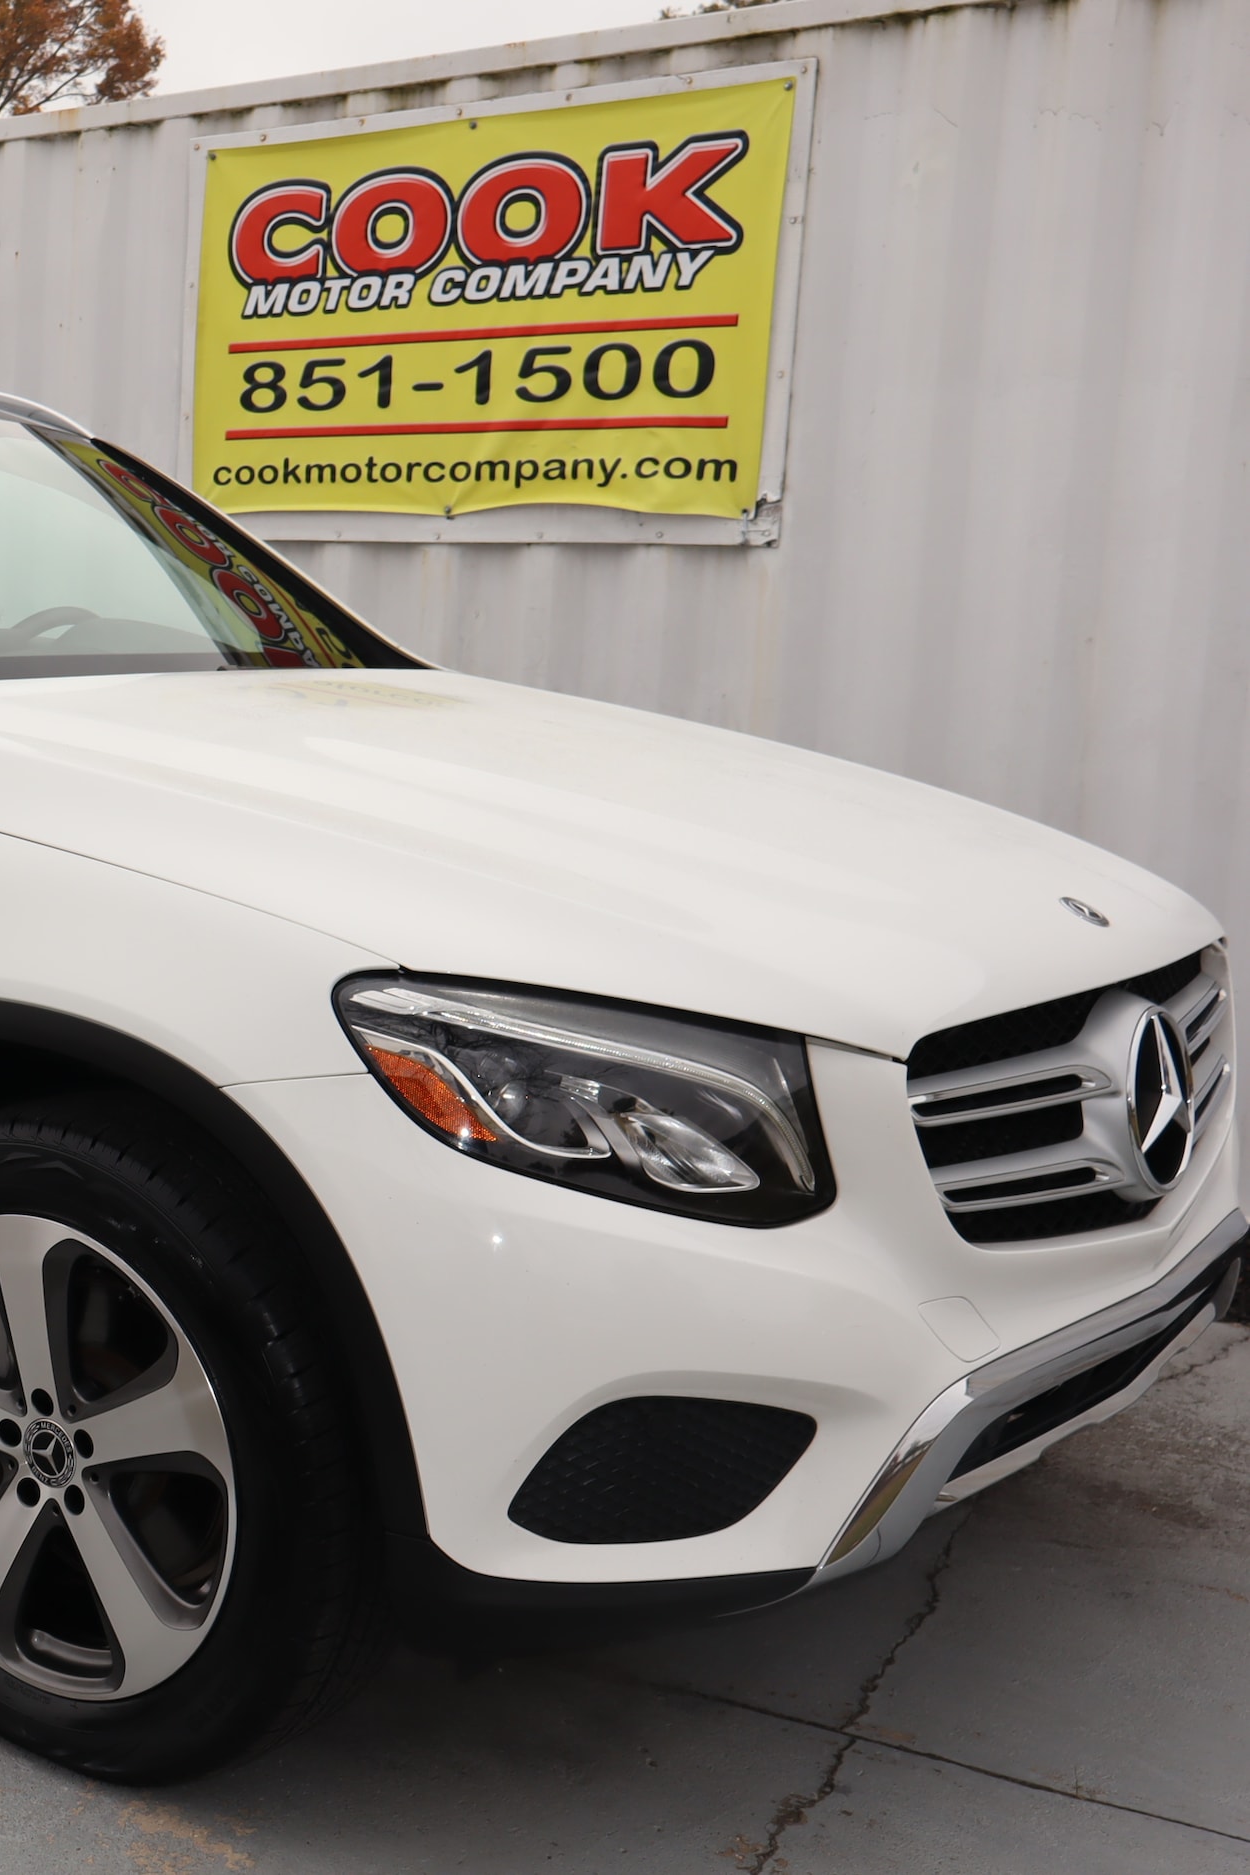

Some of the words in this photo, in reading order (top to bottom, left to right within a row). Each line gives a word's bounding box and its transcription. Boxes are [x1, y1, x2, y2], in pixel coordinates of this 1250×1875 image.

[229, 130, 749, 282] COOK
[241, 272, 415, 320] MOTOR
[428, 249, 716, 304] COMPANY
[239, 339, 716, 414] 851-1500
[212, 455, 739, 489] cookmotorcompany.com
